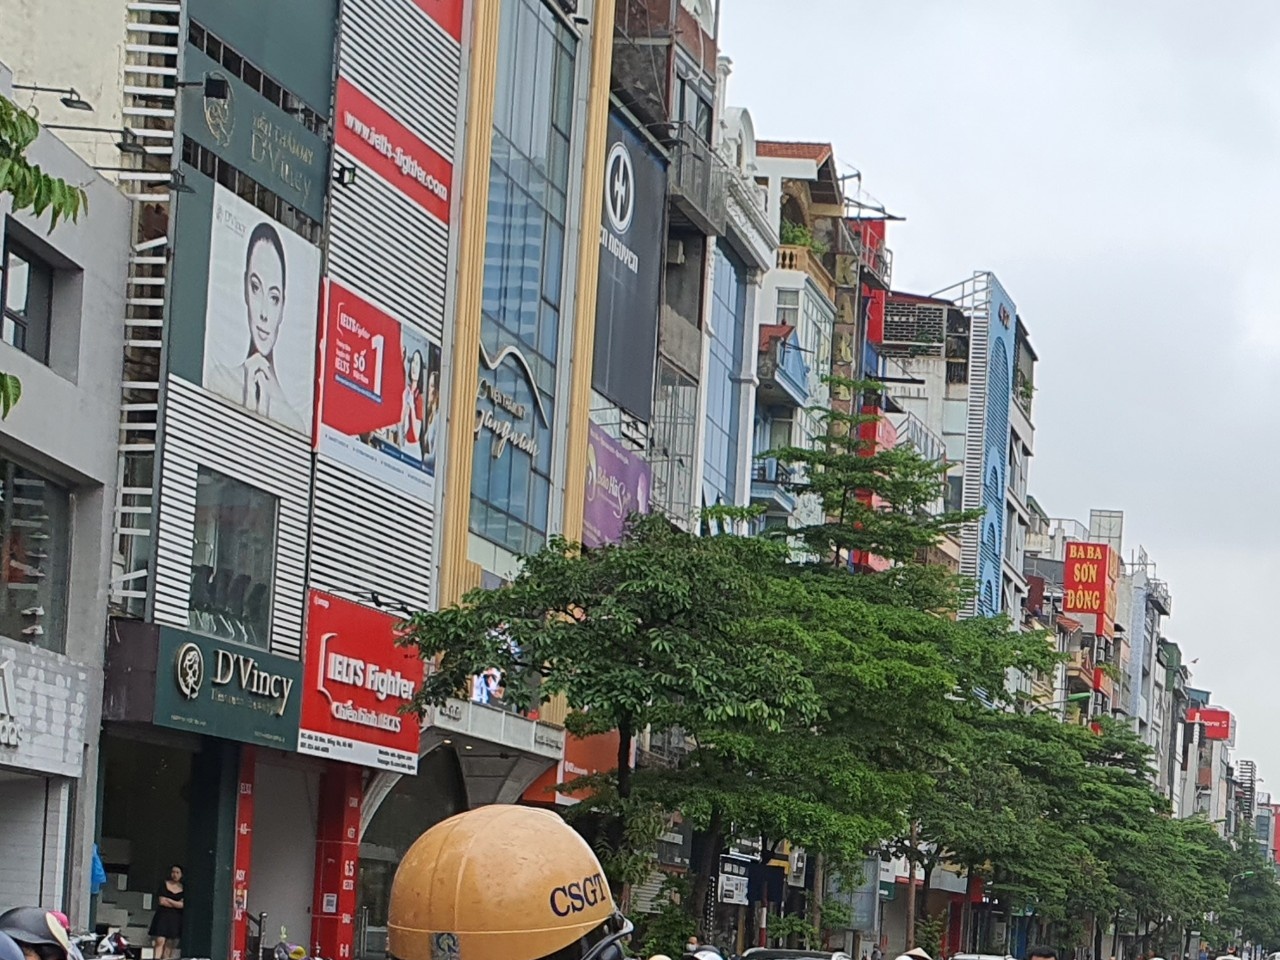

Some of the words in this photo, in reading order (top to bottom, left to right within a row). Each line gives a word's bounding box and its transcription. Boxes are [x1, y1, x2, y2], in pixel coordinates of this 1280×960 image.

[343, 110, 448, 202] www.ielts-fighter.com
[371, 333, 385, 397] 1
[1069, 544, 1086, 559] BA
[1086, 545, 1102, 560] BA
[1073, 561, 1098, 583] SƠN
[1066, 584, 1101, 610] ĐÔNG
[210, 649, 294, 717] D'Vincy
[327, 652, 365, 687] IELTS
[365, 663, 415, 700] Fighter
[550, 873, 606, 918] CSGT
